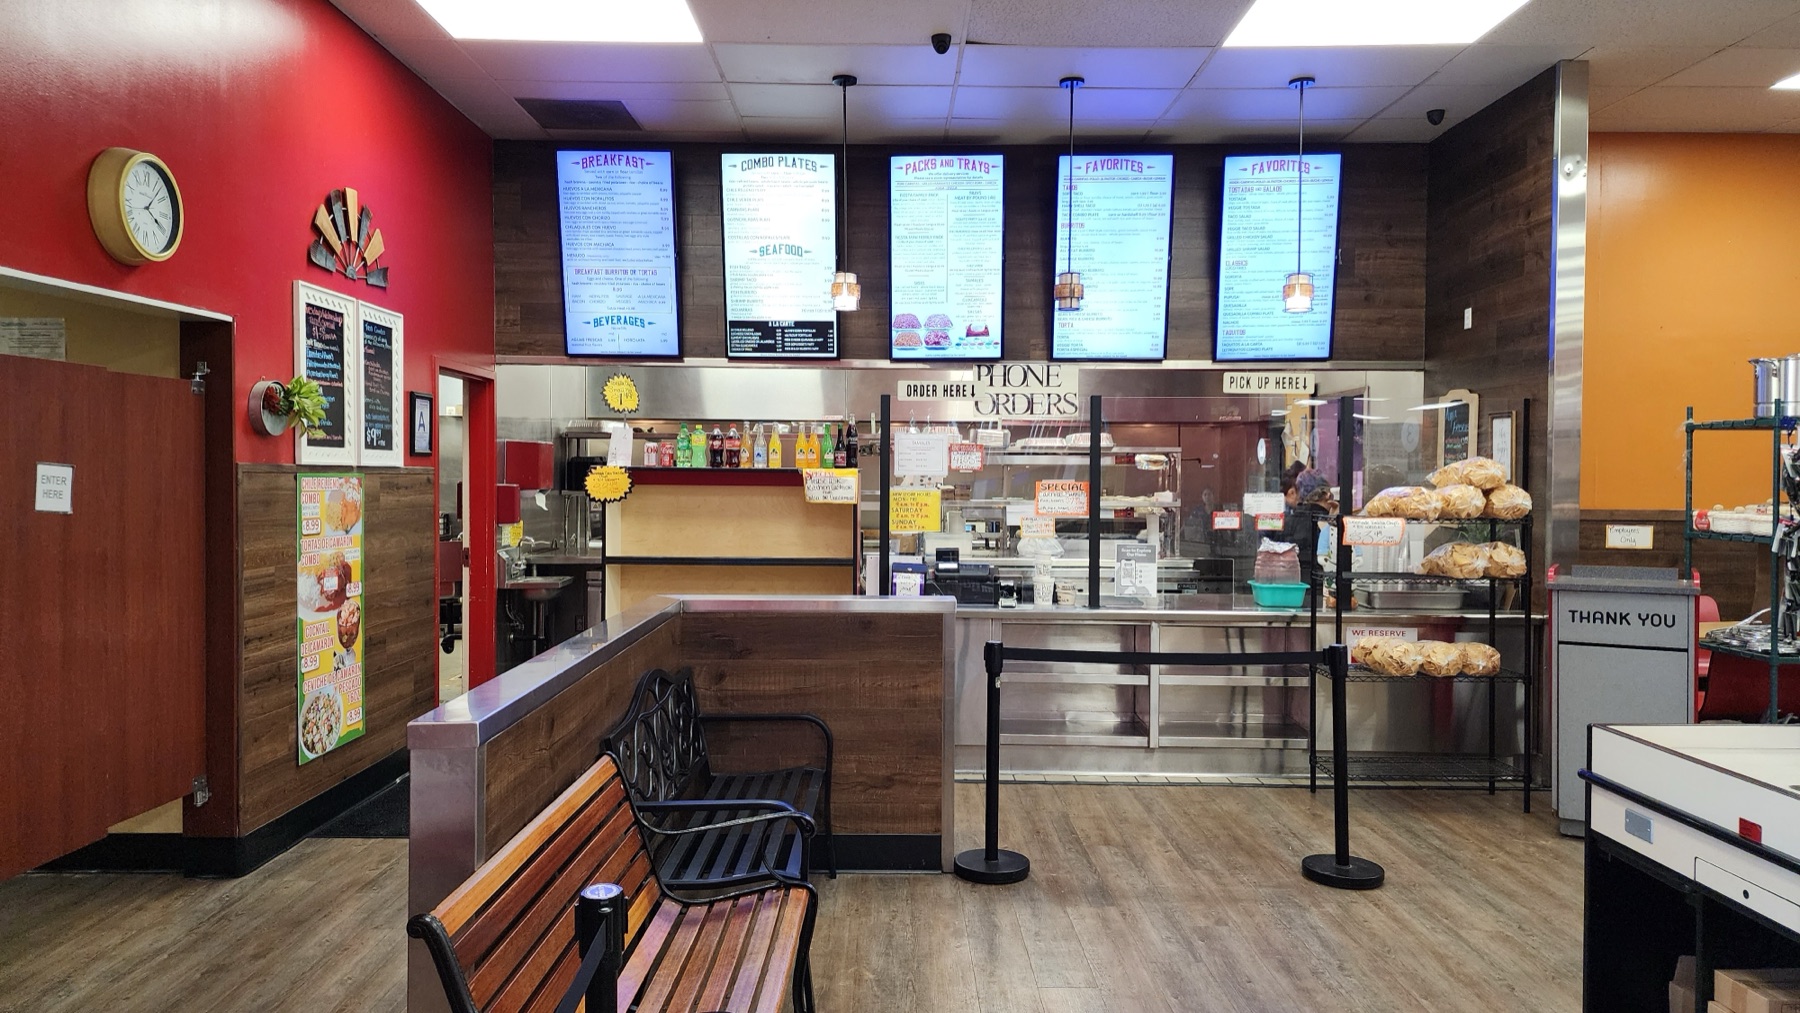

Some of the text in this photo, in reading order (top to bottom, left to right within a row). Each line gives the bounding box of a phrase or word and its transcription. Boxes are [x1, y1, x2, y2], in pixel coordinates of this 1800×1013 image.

[582, 154, 644, 170] BREAKFAST
[742, 156, 817, 172] COMBO PLATES
[906, 158, 990, 176] PACKS AND TRAYS
[1086, 158, 1144, 174] FAVORITES
[1252, 160, 1310, 176] FAVORITES
[760, 244, 803, 257] SEAFOOD
[594, 316, 646, 328] BEVERAGES
[977, 364, 1062, 388] PHONE
[1230, 376, 1300, 390] PICK UP HERE
[906, 384, 968, 398] ORDER HERE
[974, 392, 1078, 416] ORDERS
[418, 411, 426, 432] A
[41, 474, 67, 486] ENTER
[1040, 482, 1084, 492] SPECIAL
[42, 489, 64, 500] HERE
[302, 492, 320, 505] COMBO
[1610, 528, 1640, 536] Employees
[302, 536, 352, 552] TORTAS DE CAMARON
[1620, 536, 1637, 546] Only
[302, 554, 320, 566] COMBO
[1568, 610, 1676, 628] THANK YOU
[306, 622, 330, 637] COCKTAIL
[1352, 629, 1406, 638] WE RESERVE
[302, 636, 334, 655] DE CAMARON
[337, 664, 362, 681] CAMARON
[338, 678, 362, 694] PESCADO
